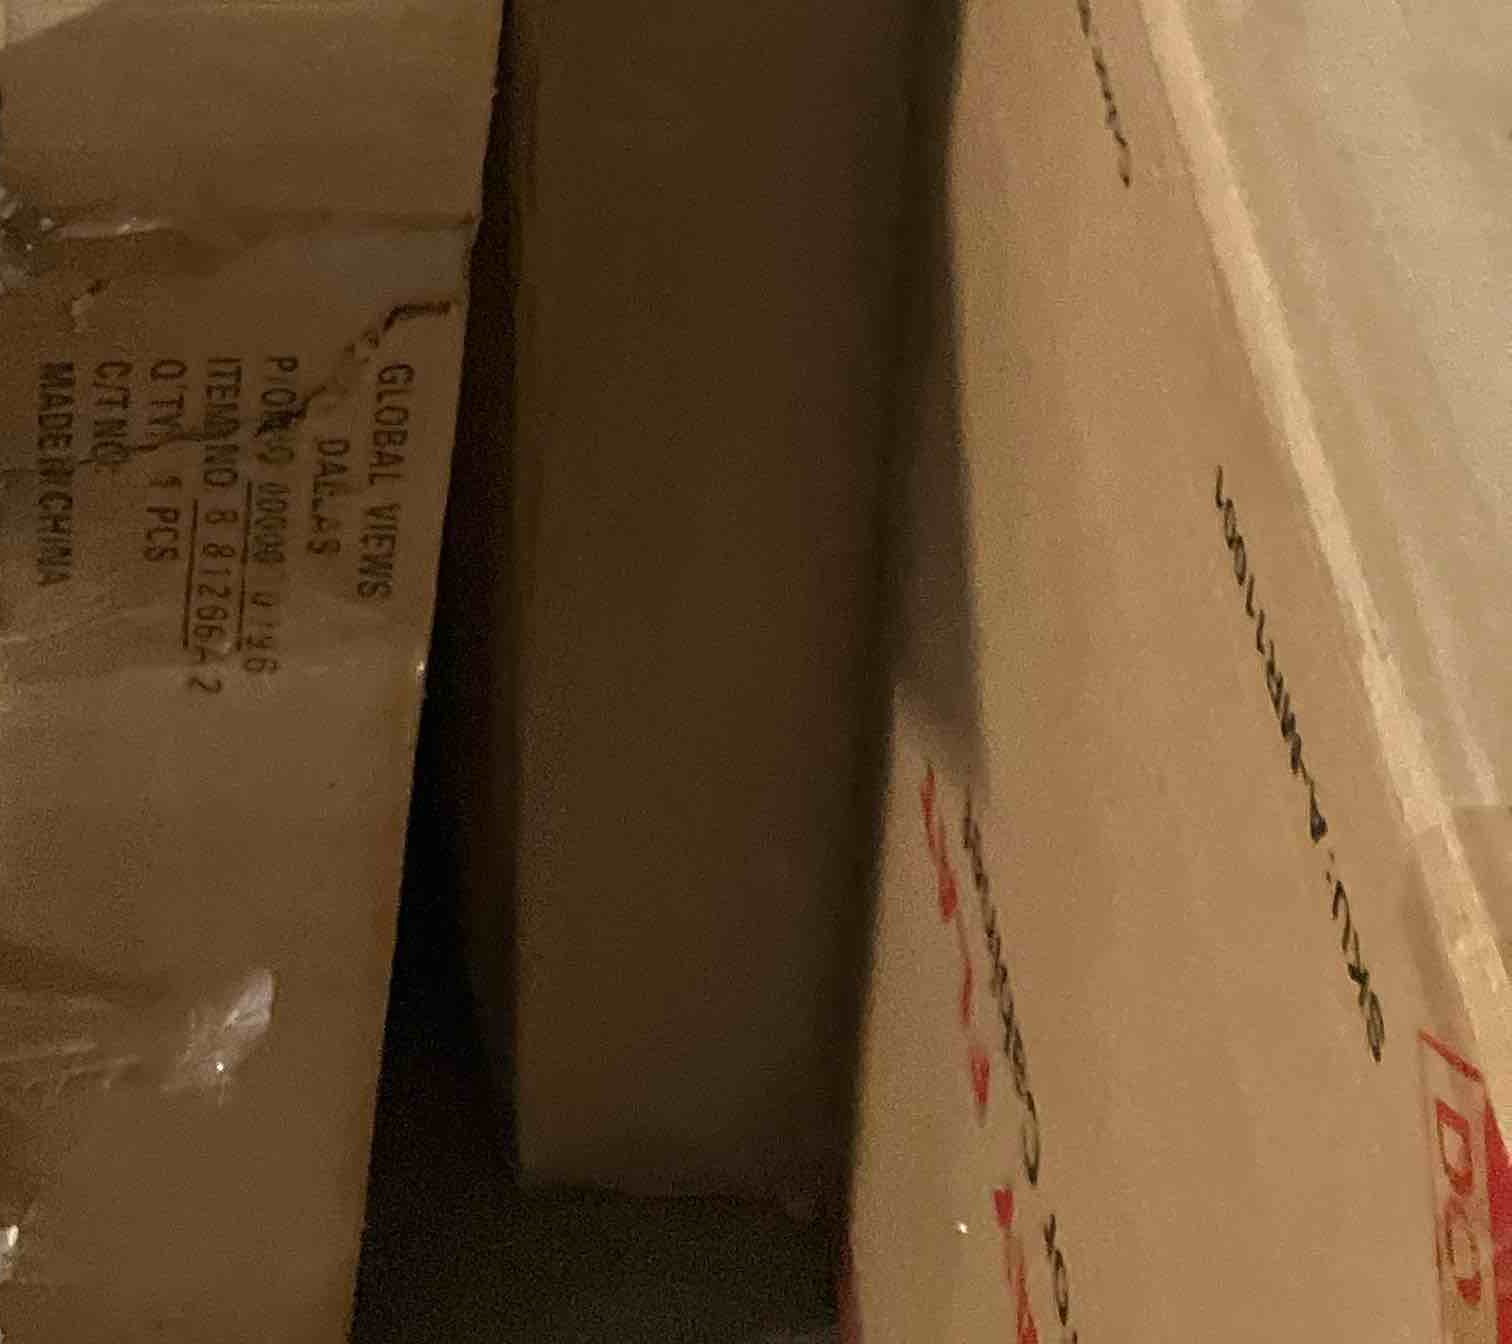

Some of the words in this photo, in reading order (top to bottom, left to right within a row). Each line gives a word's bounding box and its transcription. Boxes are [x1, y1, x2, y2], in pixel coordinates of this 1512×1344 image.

[368, 362, 415, 487] GLOBAL
[36, 491, 75, 587] CHINA
[144, 506, 181, 563] PCS
[356, 503, 400, 601] VIEWS
